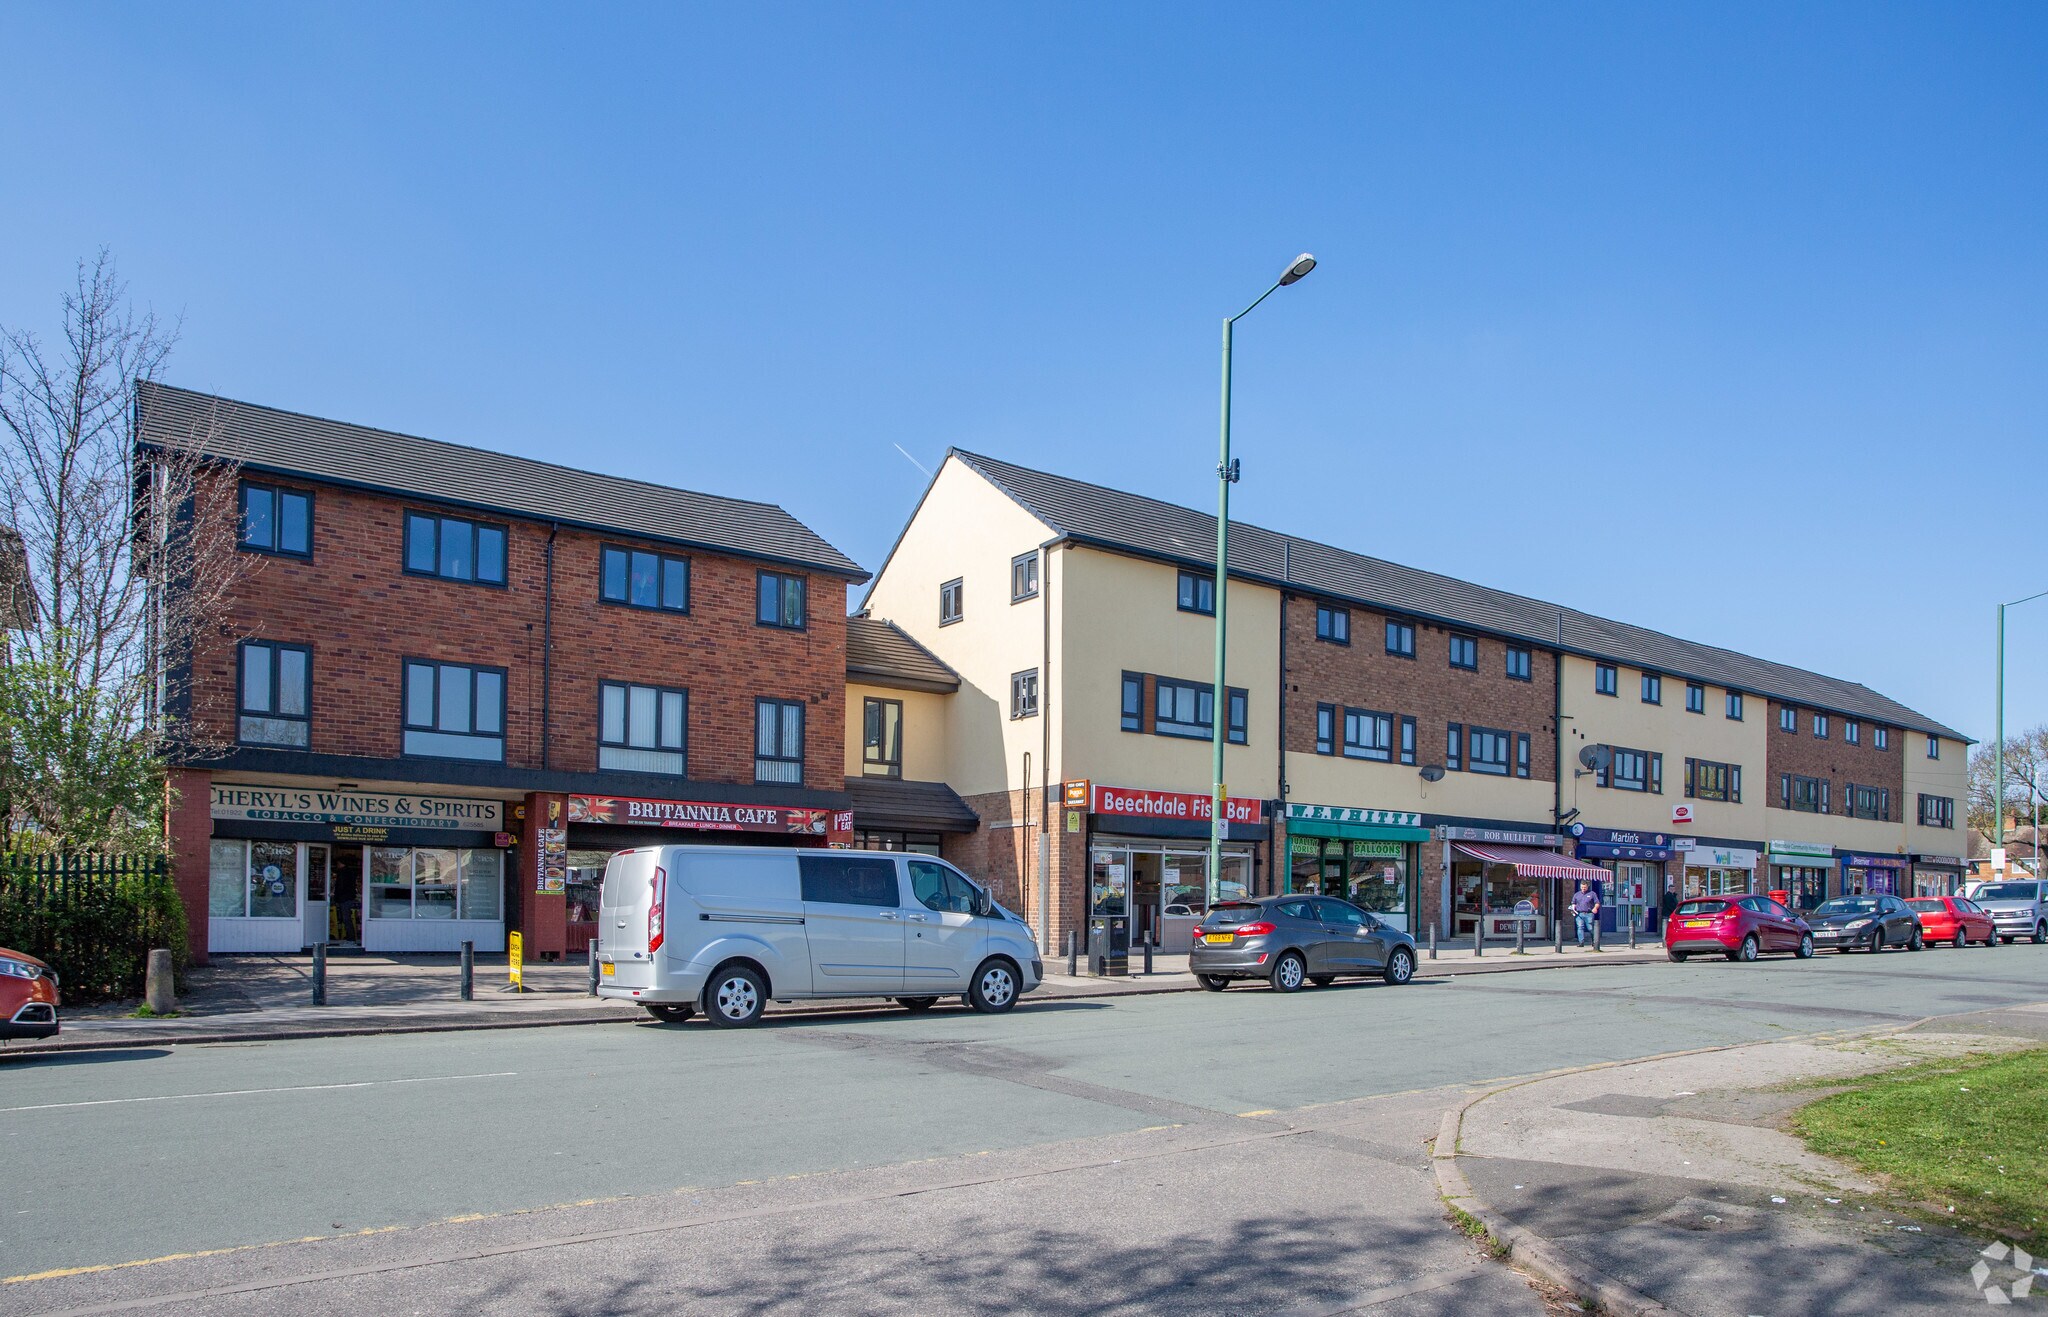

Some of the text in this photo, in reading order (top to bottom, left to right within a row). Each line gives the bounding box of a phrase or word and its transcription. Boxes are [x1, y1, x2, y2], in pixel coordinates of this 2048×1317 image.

[316, 793, 389, 814] WINES
[394, 797, 414, 815] &
[419, 799, 496, 819] SPIRITS
[1104, 791, 1251, 820] Beechdale Fis Bar
[627, 801, 777, 825] BRITANNIA CAFE
[838, 812, 852, 822] JUST
[254, 810, 452, 828] TOBACCO & CONFECTIONARY
[362, 827, 387, 835] DRINK
[841, 822, 852, 831] EAT
[537, 828, 545, 848] CAFE
[1293, 837, 1319, 847] UALITY
[1484, 831, 1500, 840] ROB
[1503, 832, 1537, 842] MULLETT
[1610, 832, 1639, 844] Martin's
[1293, 845, 1319, 855] LORIST
[1354, 844, 1401, 855] BALLOONS
[1715, 850, 1731, 865] well
[537, 849, 545, 890] BRITANNIA
[1499, 922, 1531, 931] DEWHST
